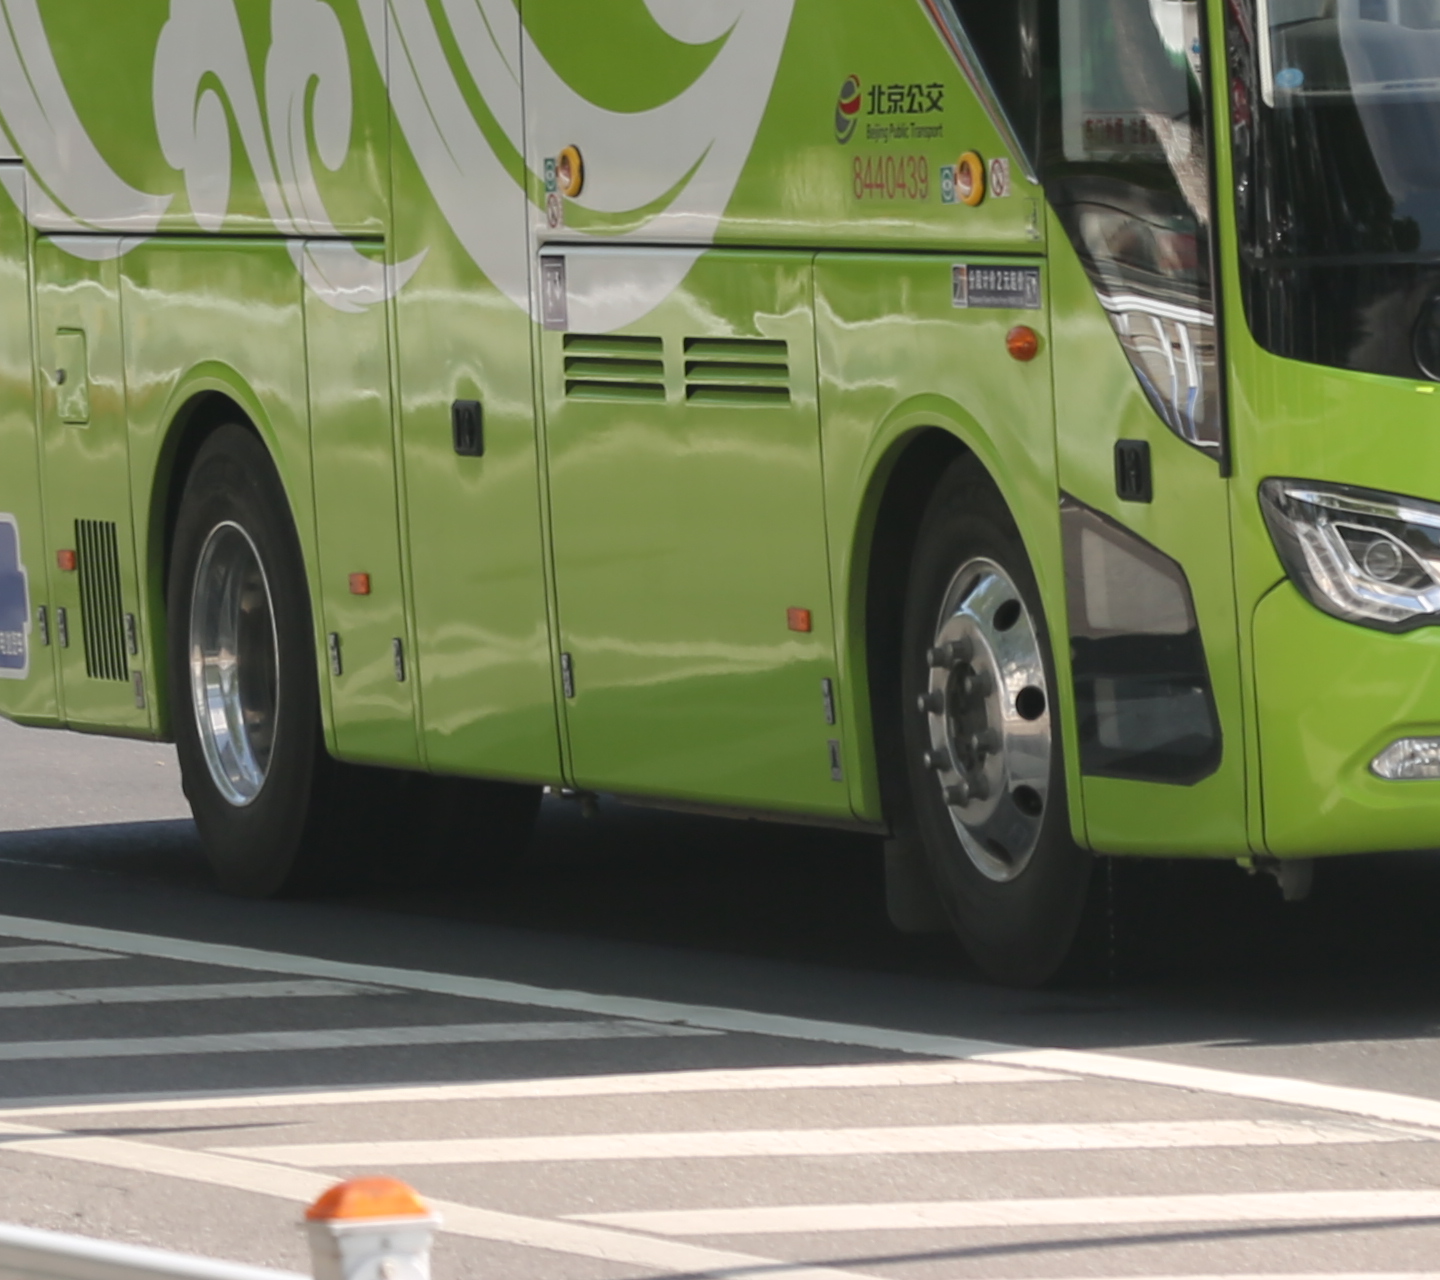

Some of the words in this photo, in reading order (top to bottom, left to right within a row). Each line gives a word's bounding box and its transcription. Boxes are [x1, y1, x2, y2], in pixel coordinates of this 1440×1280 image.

[867, 83, 944, 115] 北京公交
[853, 156, 929, 200] 8440439
